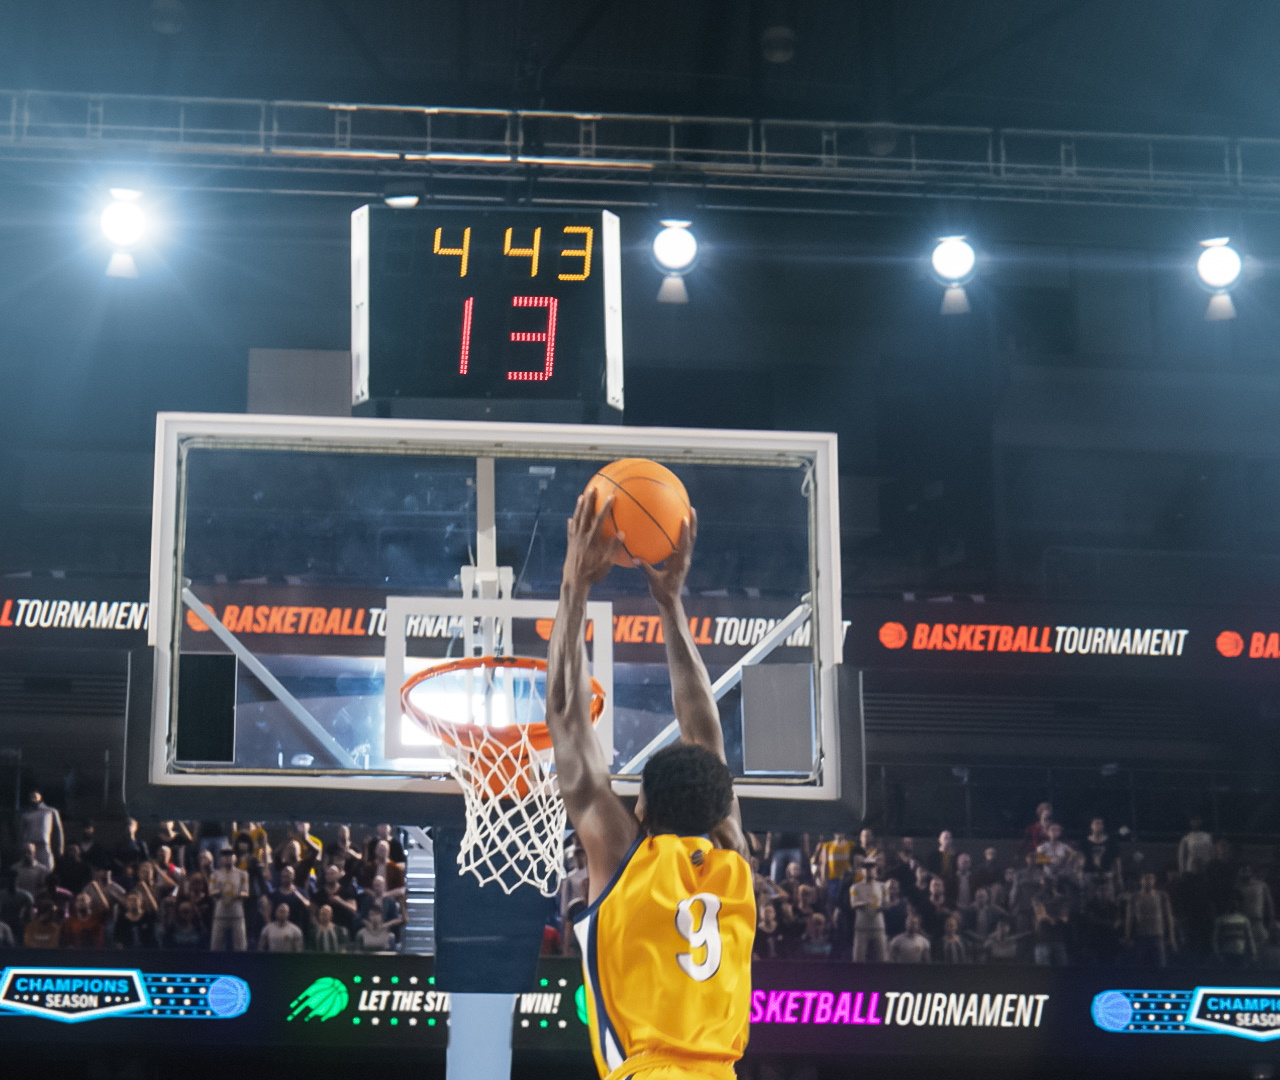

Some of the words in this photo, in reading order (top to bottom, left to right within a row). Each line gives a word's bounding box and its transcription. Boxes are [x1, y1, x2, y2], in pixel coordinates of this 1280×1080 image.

[433, 226, 471, 278] 4
[459, 296, 558, 380] 13
[222, 603, 367, 636] BASKETBALL
[911, 622, 1053, 653] BASKETBALL
[1054, 626, 1189, 656] TOURNAMENT
[675, 892, 722, 982] 9
[15, 977, 129, 993] CHAMPIONS
[45, 993, 98, 1008] SEASON
[358, 989, 391, 1011] LET
[391, 990, 424, 1012] THE
[519, 992, 562, 1014] WIN!
[751, 988, 883, 1026] SKETBALL
[884, 991, 1050, 1028] TOURNAMENT
